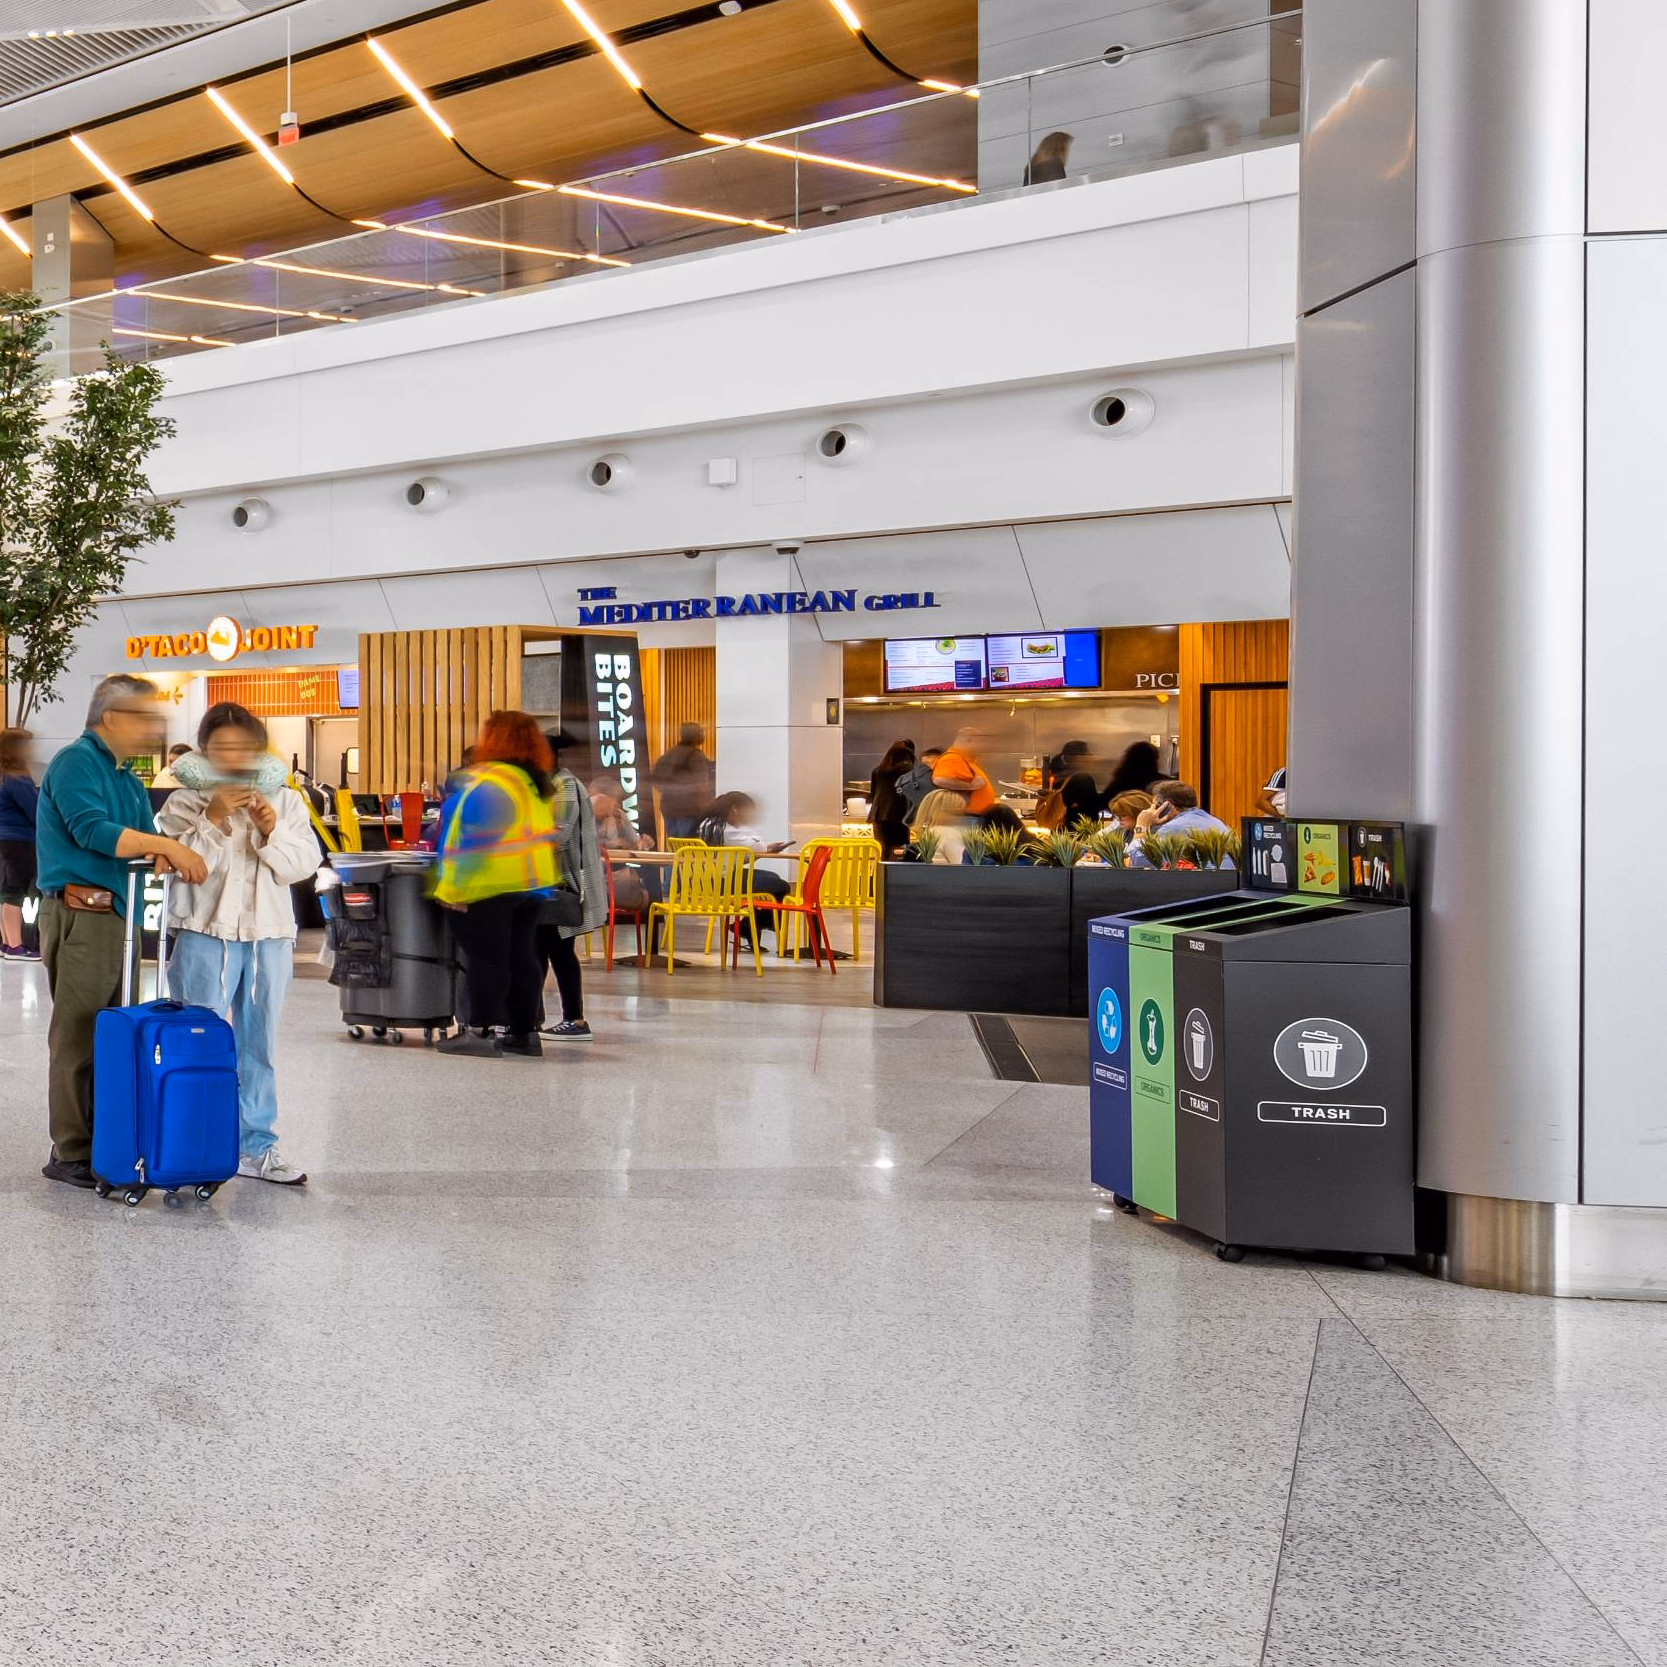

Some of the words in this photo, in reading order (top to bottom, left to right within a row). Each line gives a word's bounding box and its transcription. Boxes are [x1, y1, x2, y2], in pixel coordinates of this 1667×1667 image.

[577, 586, 617, 602] THE
[864, 591, 941, 612] GRILL
[125, 632, 208, 659] D'TACO
[238, 624, 319, 653] JOINT
[594, 653, 617, 768] BITES
[1103, 926, 1125, 939] RECYCLING
[1139, 933, 1162, 944] ORGANICS
[1189, 939, 1205, 951] TRASH
[1105, 1070, 1125, 1085] RECYCLING
[1141, 1082, 1164, 1097] ORGANICS
[1189, 1096, 1209, 1113] TRASH
[1291, 1106, 1351, 1120] TRASH
